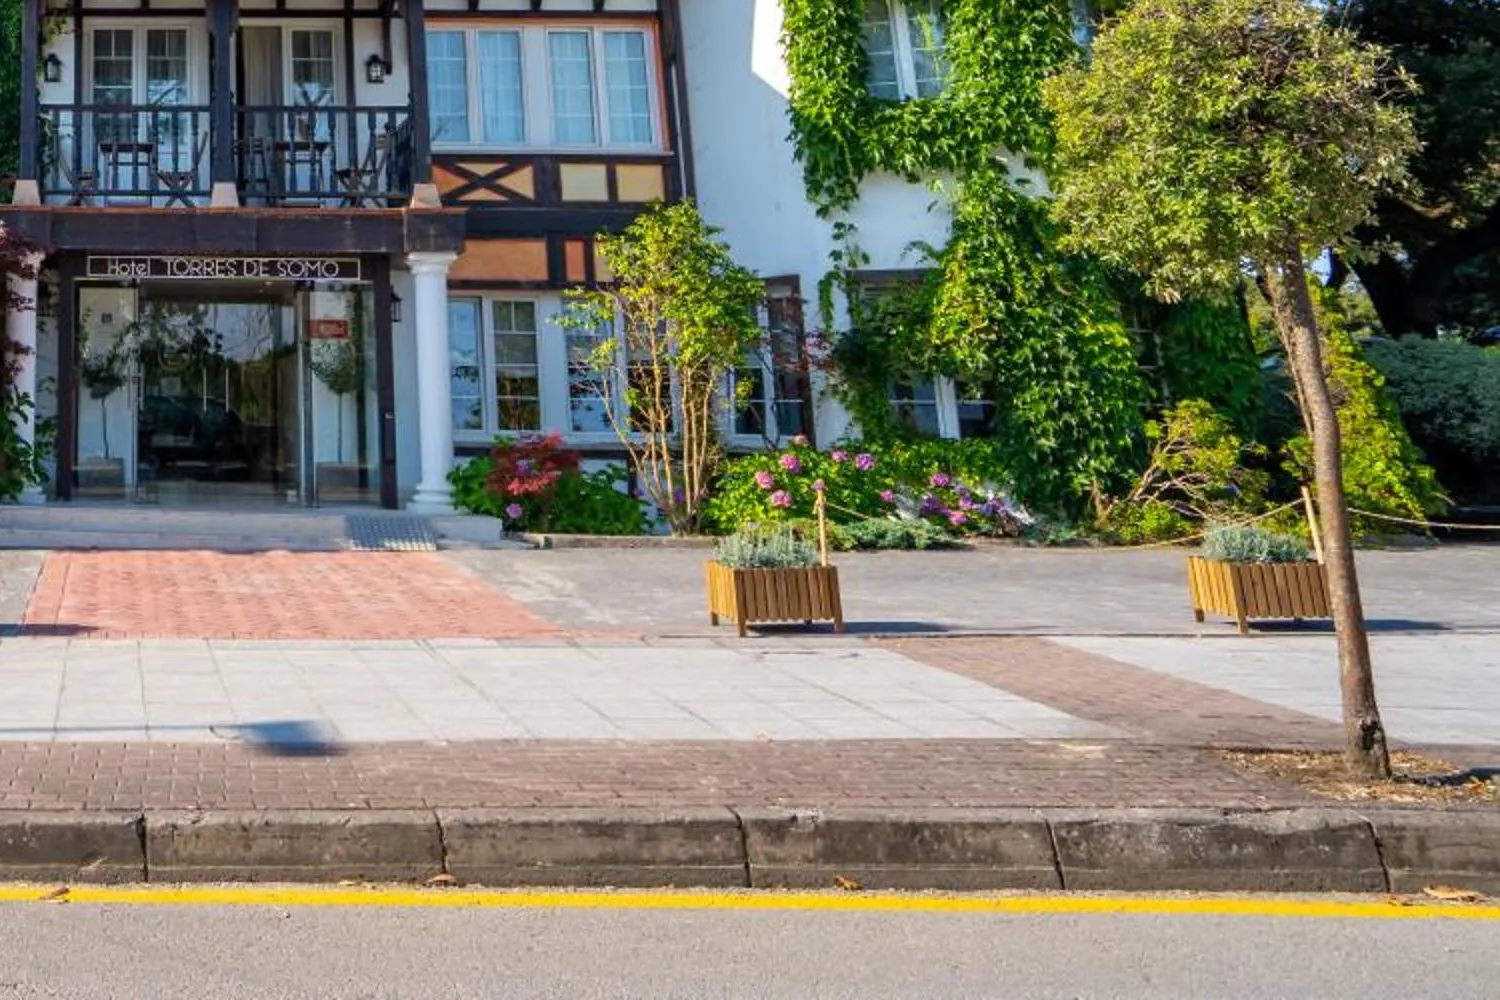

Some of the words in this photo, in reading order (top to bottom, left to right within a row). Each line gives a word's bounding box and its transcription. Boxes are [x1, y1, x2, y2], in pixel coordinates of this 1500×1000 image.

[107, 257, 150, 277] Hotel
[166, 258, 236, 277] TORRES
[244, 259, 269, 277] DE
[277, 259, 339, 278] SOMO
